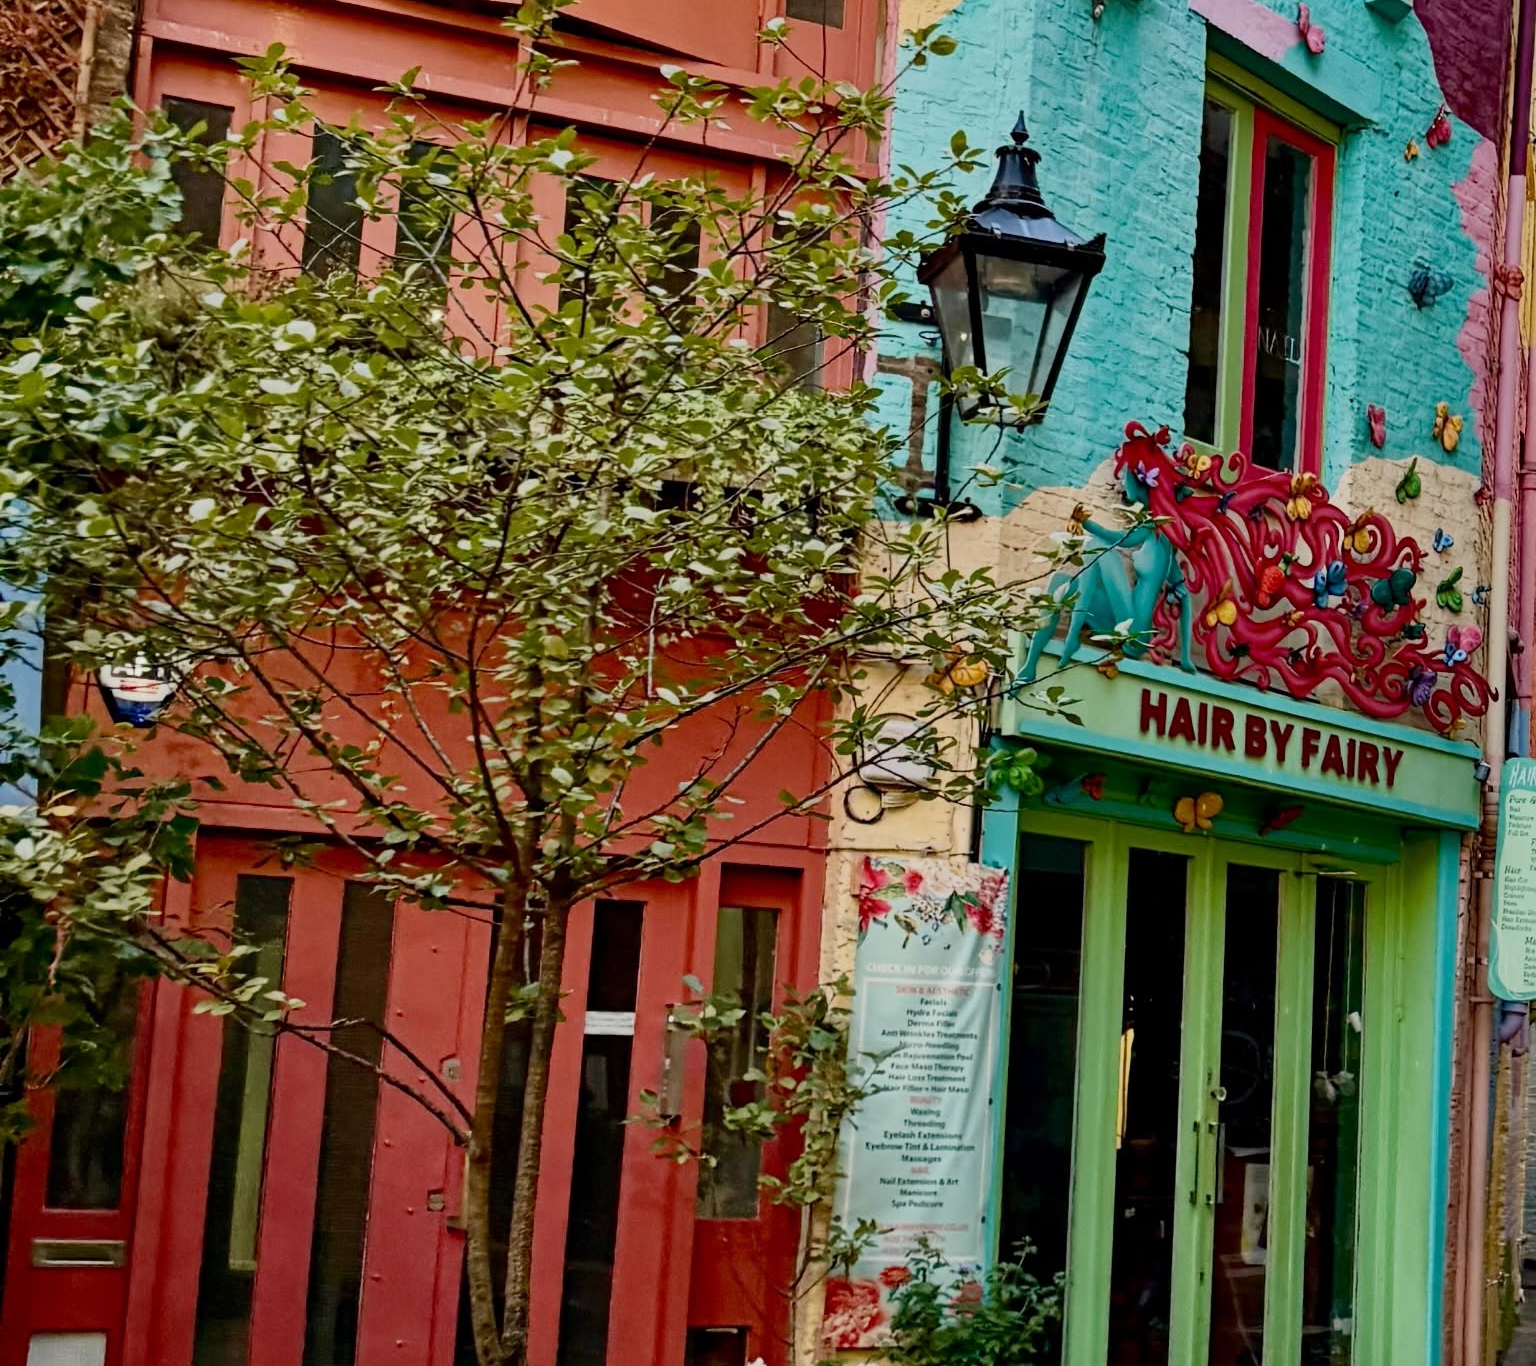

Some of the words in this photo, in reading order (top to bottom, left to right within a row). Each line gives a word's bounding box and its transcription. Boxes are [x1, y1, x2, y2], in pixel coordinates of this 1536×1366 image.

[1139, 687, 1236, 752] HAIR
[1244, 714, 1295, 764] BY
[1301, 726, 1405, 788] FAIRY
[1504, 865, 1521, 874] Hair
[920, 997, 947, 1006] Facials
[906, 1009, 930, 1017] Hydra
[907, 1019, 934, 1027] Derma
[891, 1062, 909, 1070] Face
[934, 1063, 964, 1073] Therapy
[910, 1108, 941, 1117] Waxing
[904, 1119, 946, 1129] Threading
[884, 1131, 916, 1140] Eyelash
[865, 1142, 903, 1151] Eyebrow
[905, 1142, 921, 1151] Tint
[922, 1143, 929, 1151] &
[901, 1155, 942, 1164] Massages
[880, 1177, 896, 1186] Nail
[939, 1178, 945, 1186] &
[946, 1178, 959, 1186] Art
[891, 1200, 907, 1209] Spa
[908, 1200, 944, 1208] Pedicure
